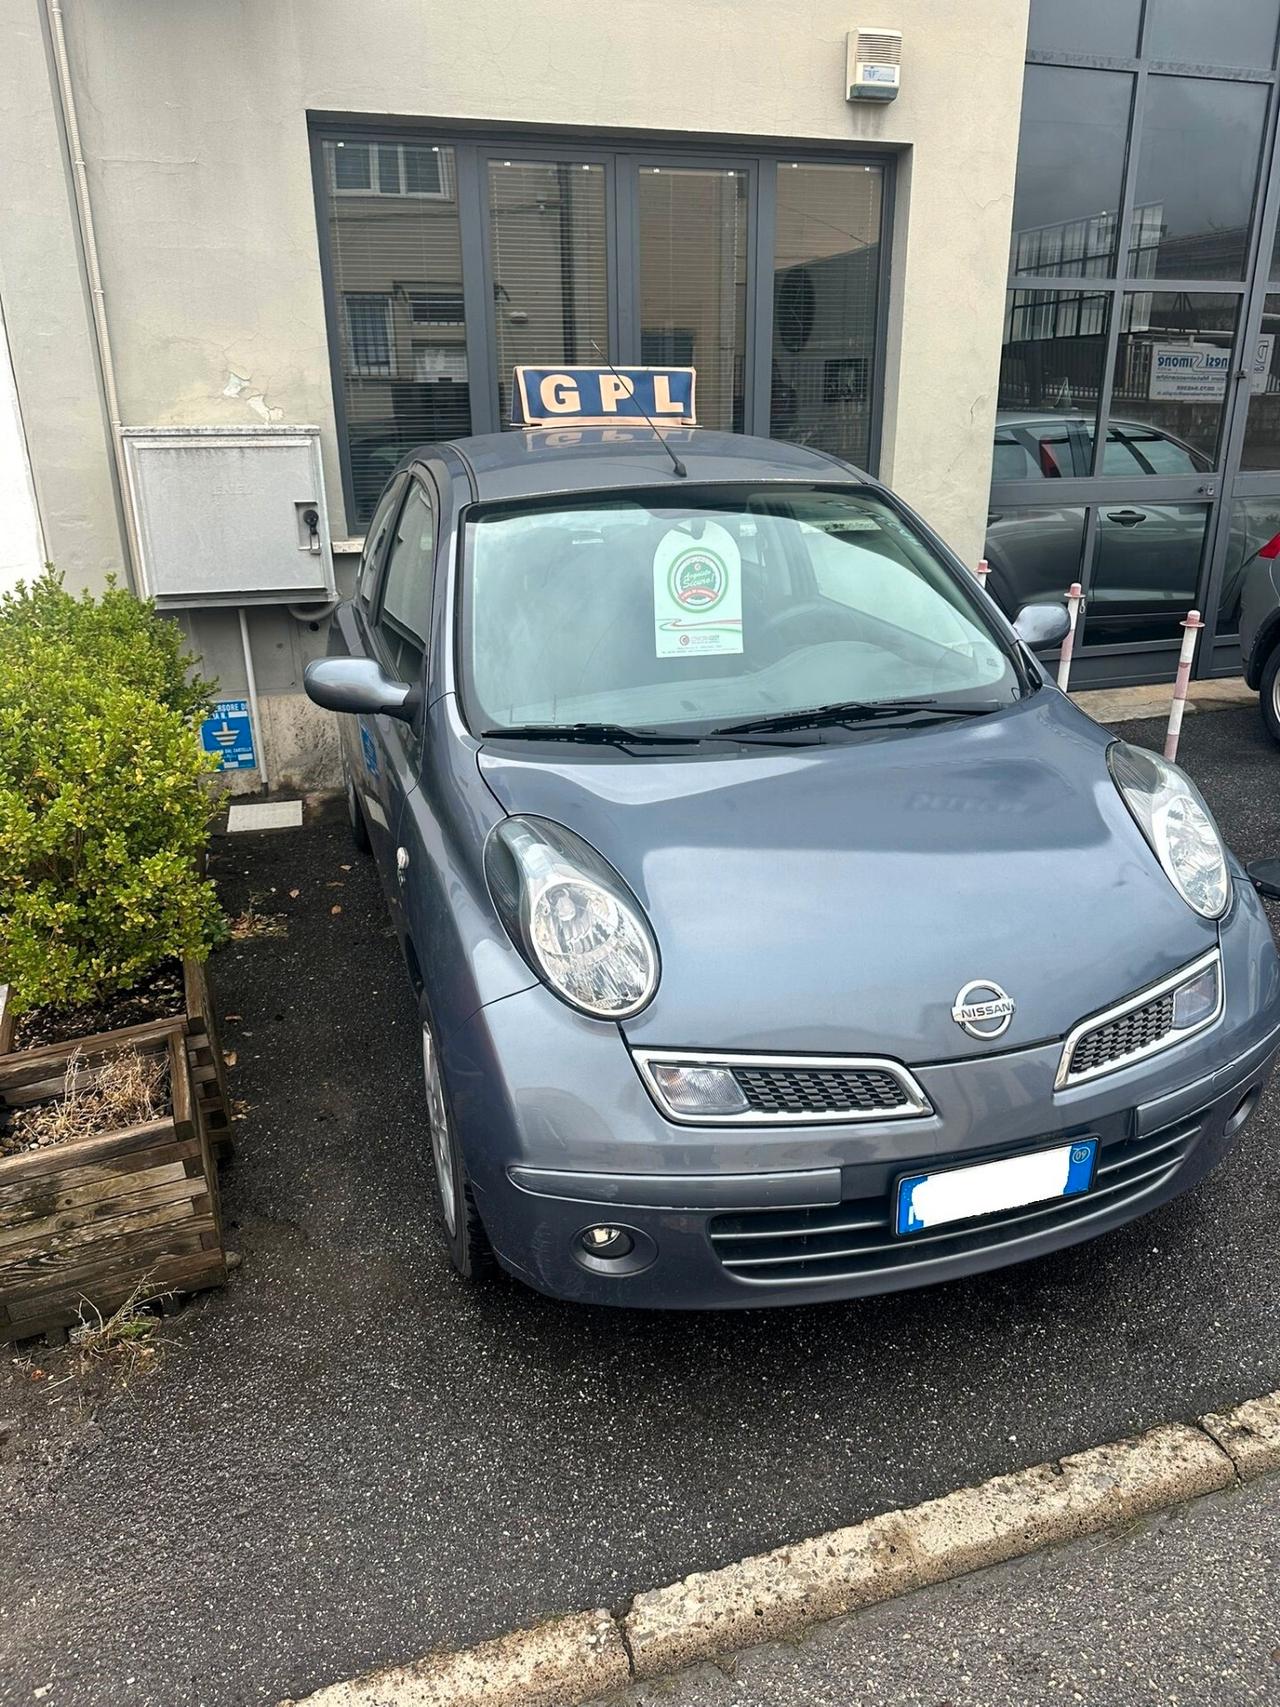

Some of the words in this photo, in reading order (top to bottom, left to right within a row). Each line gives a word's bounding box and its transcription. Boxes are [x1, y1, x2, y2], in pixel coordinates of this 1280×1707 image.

[540, 374, 684, 413] GPL
[961, 1002, 1011, 1019] NISSAN
[1075, 1149, 1086, 1160] 09
